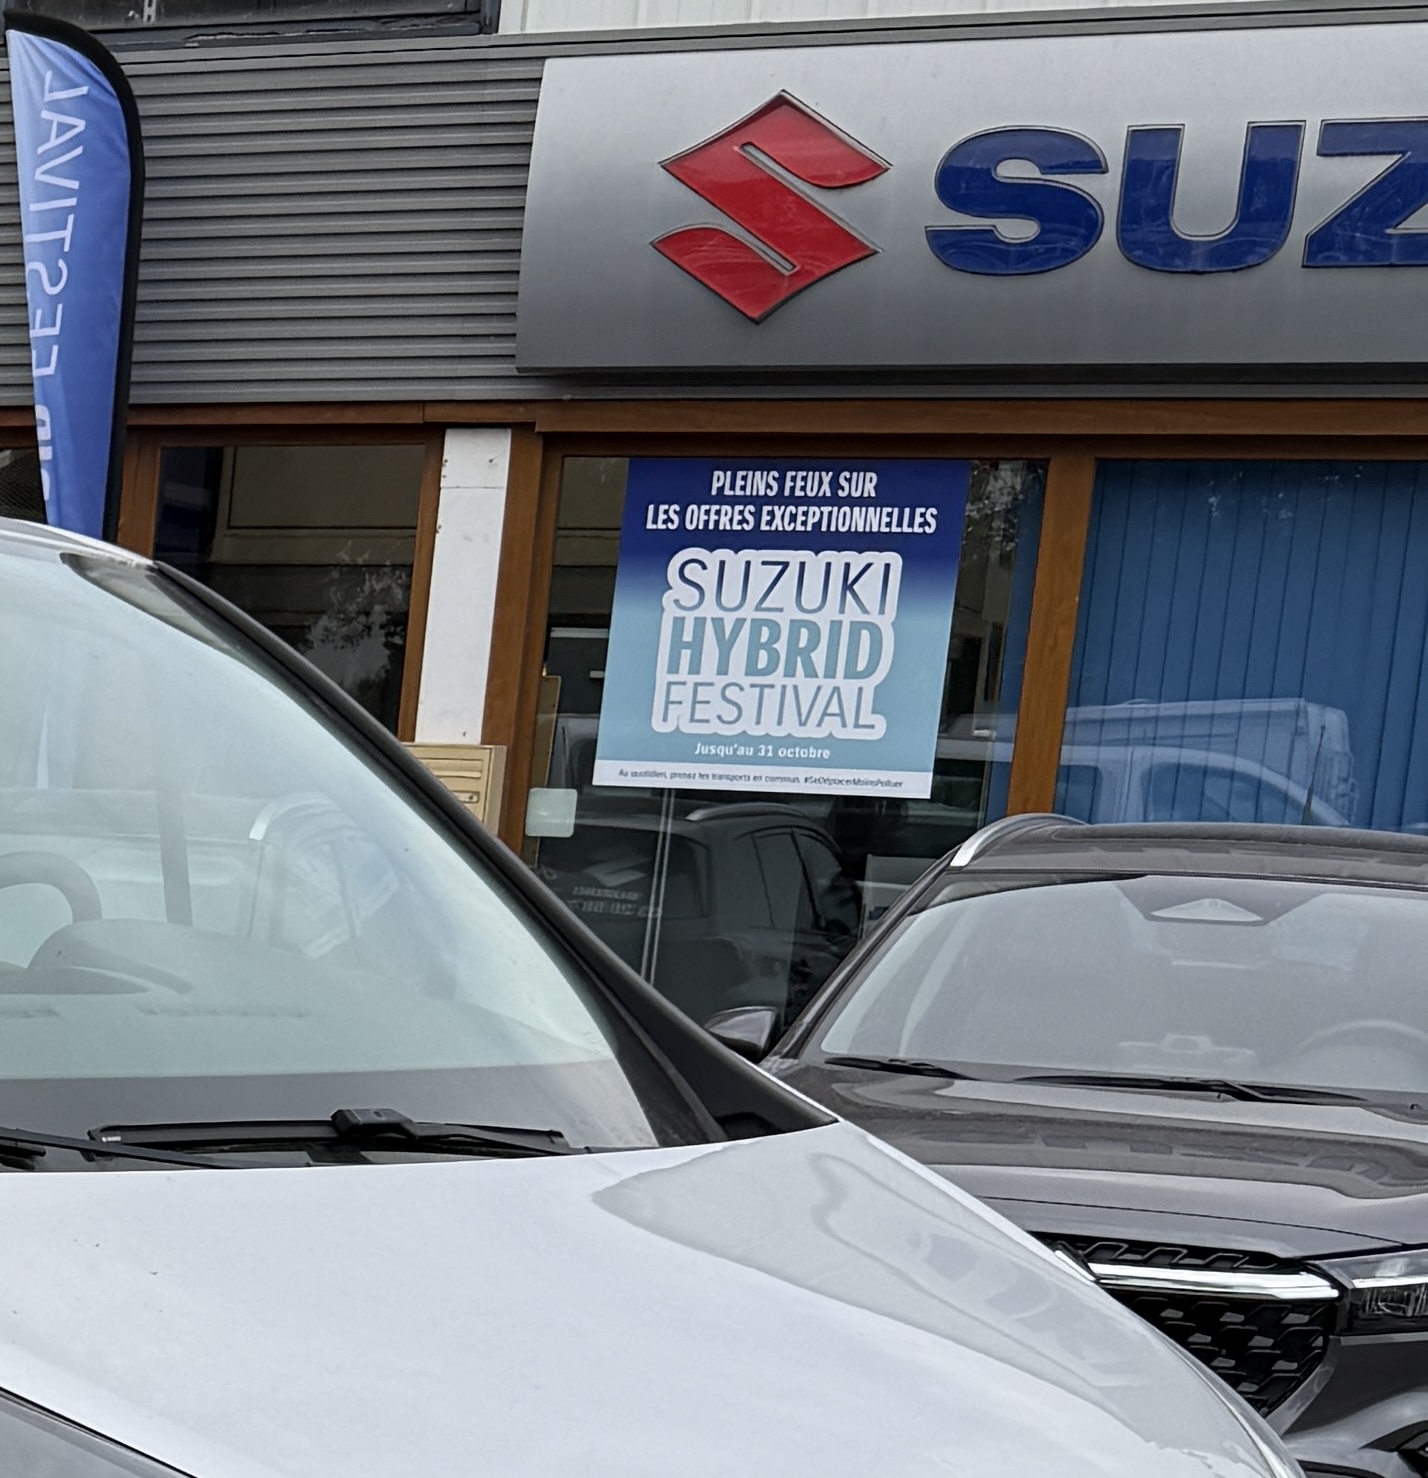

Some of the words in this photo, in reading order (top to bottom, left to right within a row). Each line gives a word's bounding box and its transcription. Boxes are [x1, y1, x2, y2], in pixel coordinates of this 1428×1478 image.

[711, 470, 779, 497] PLEINS
[783, 471, 831, 498] FEUX
[837, 471, 878, 498] SUR
[646, 504, 679, 531] LES
[684, 505, 755, 532] OFFRES
[760, 505, 938, 534] EXCEPTIONNELLES
[673, 558, 892, 615] SUZUKI
[666, 616, 883, 680] HYBRID
[662, 681, 876, 730] FESTIVAL
[695, 742, 754, 758] Jusqu'au
[758, 745, 773, 757] 31
[778, 746, 831, 759] octobre
